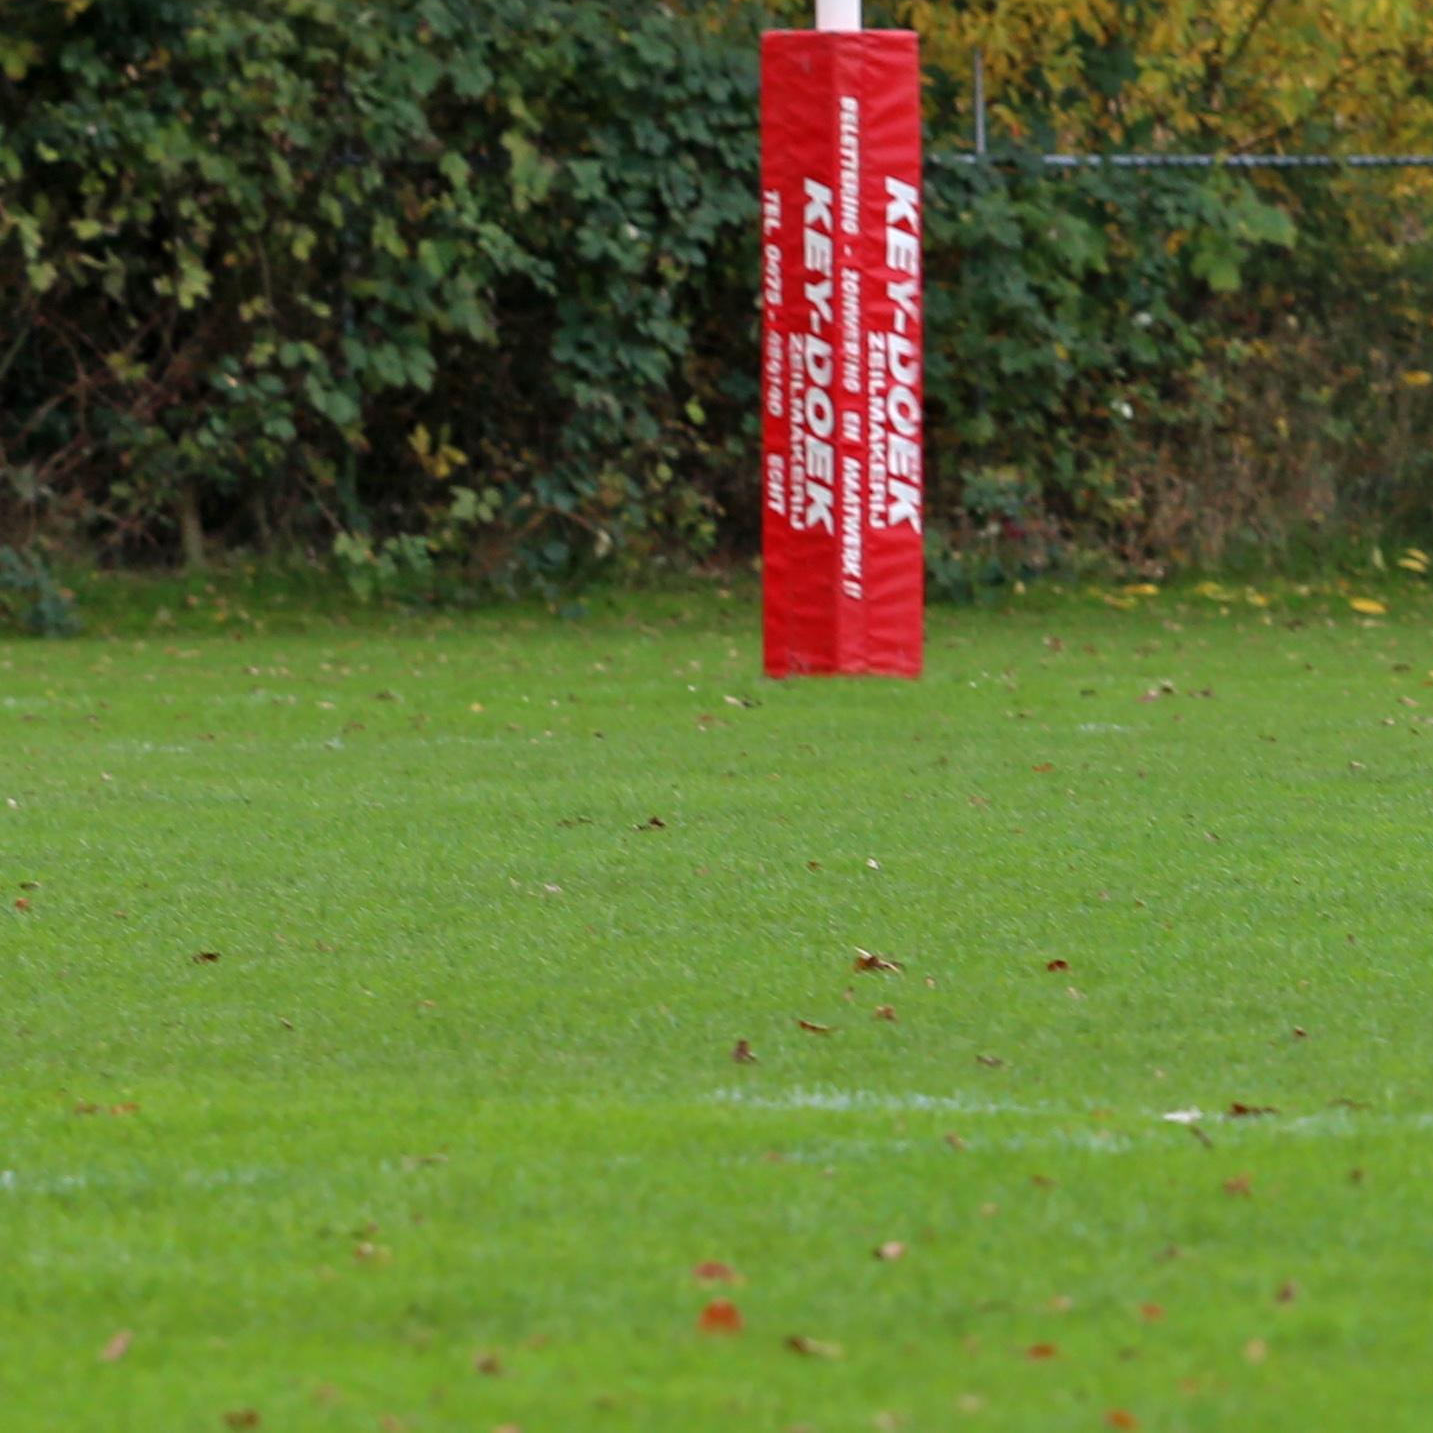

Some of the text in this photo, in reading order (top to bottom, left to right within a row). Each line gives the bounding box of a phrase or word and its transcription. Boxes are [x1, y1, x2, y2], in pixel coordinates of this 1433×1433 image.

[788, 331, 804, 530] ZEILMAKERIJ
[802, 176, 834, 536] KEY-DOEK
[842, 411, 860, 442] EN
[866, 331, 886, 529] ZEILMAKERIJ
[884, 174, 922, 536] KEY-DOEK
